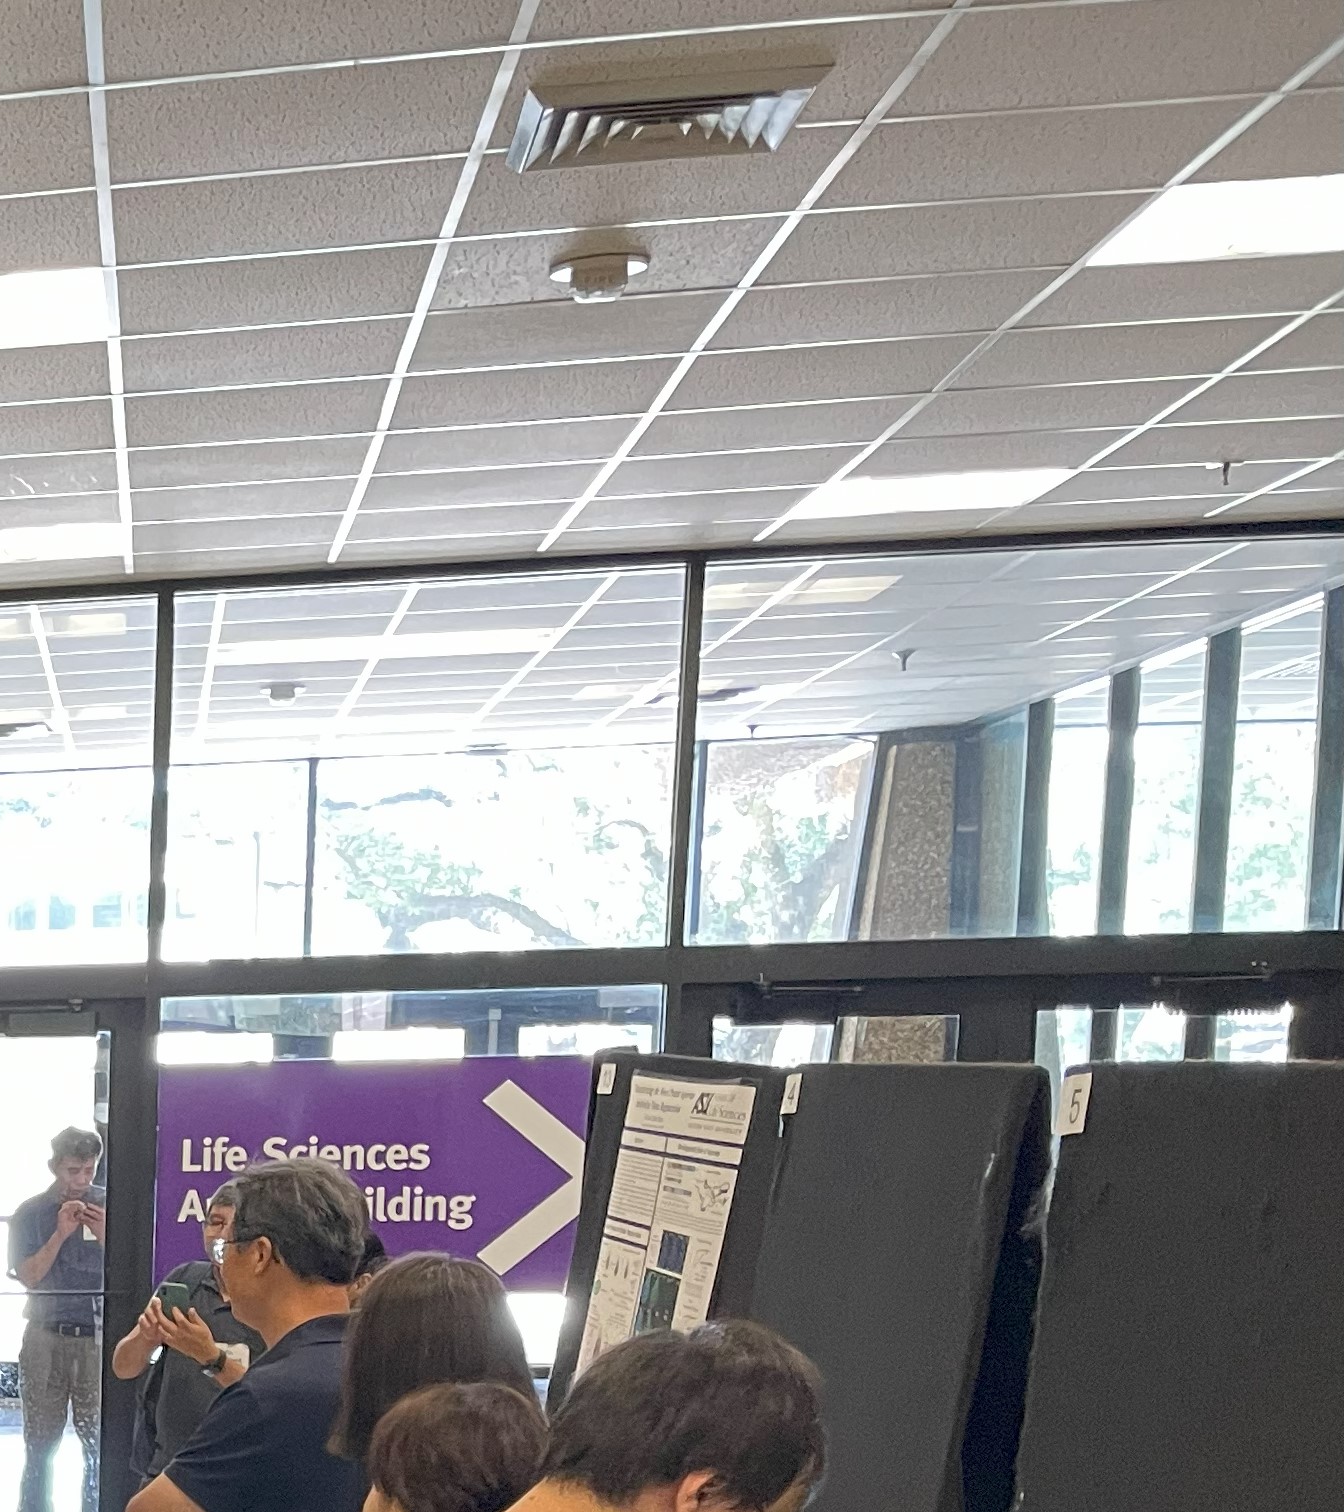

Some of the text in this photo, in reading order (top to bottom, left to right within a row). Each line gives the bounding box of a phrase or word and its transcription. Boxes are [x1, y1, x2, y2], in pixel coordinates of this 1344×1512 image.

[787, 1081, 797, 1105] 4
[1069, 1088, 1082, 1124] 5
[181, 1135, 431, 1172] Life Sciences
[365, 1186, 477, 1231] ilding
